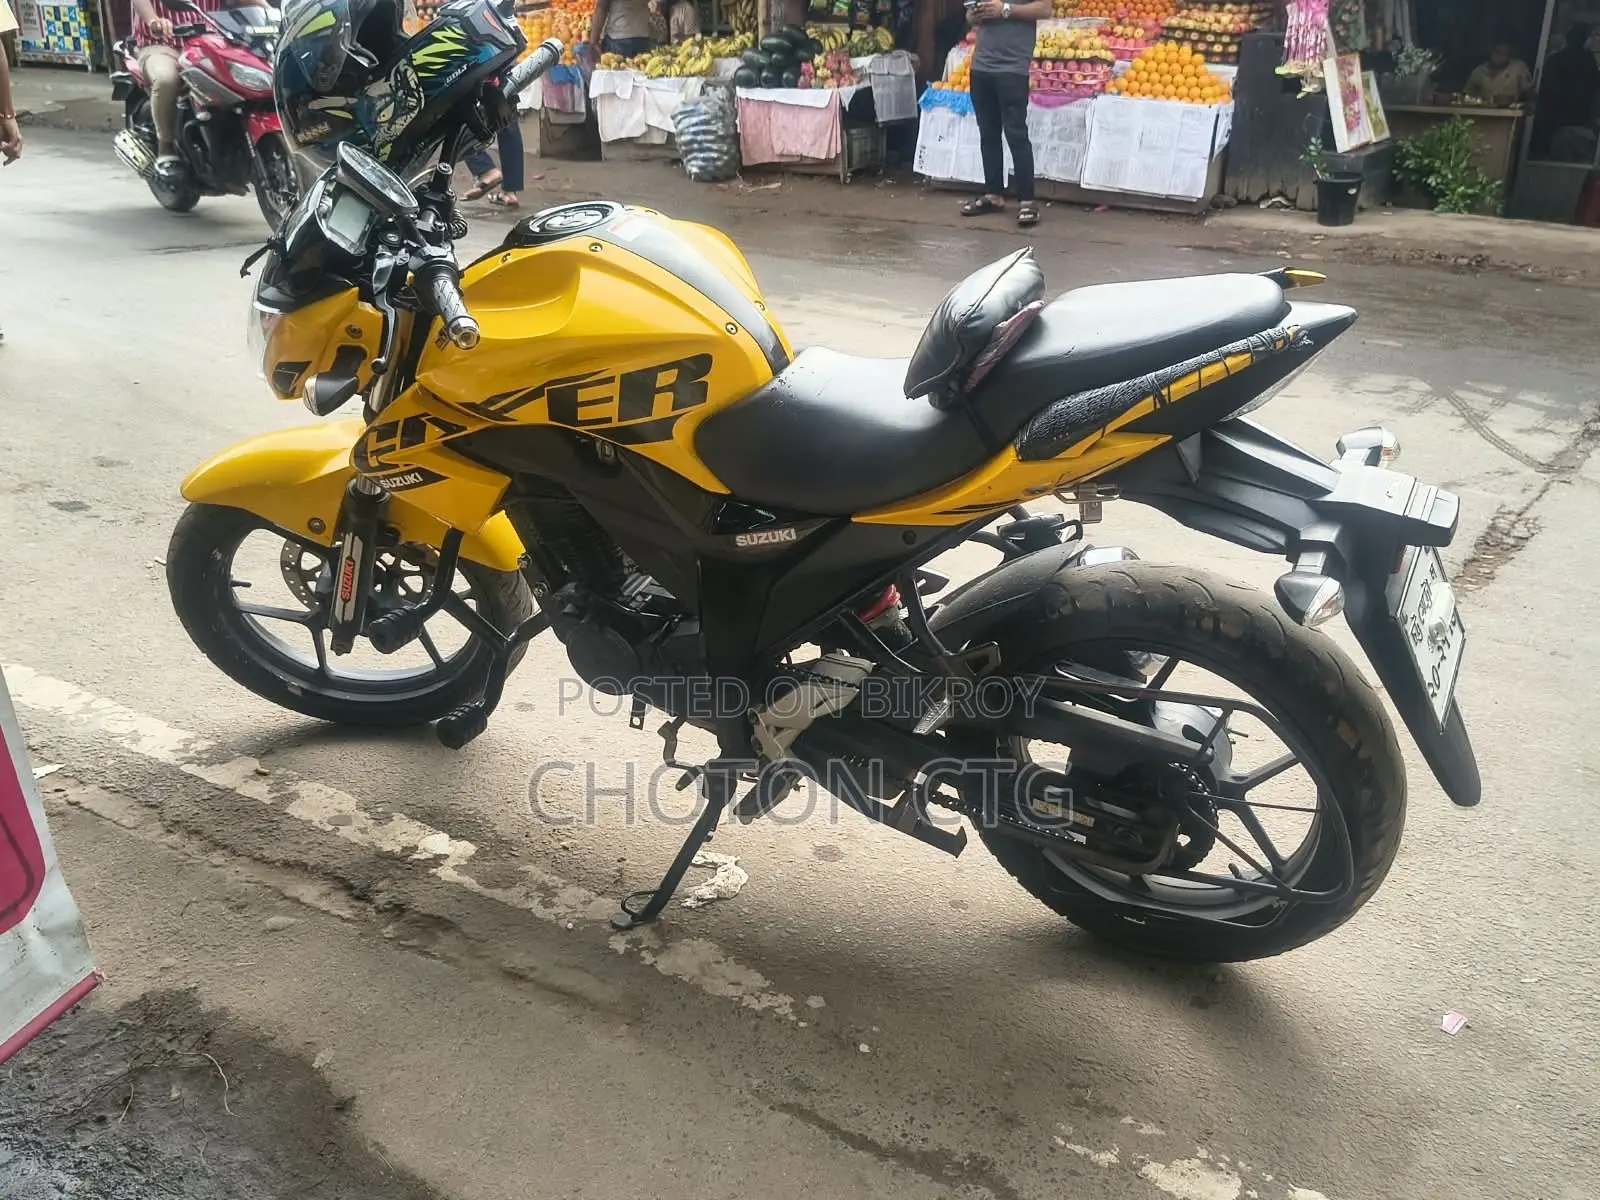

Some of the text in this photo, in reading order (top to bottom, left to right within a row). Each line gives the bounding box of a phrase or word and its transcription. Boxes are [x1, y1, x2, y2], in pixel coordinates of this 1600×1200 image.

[379, 472, 424, 490] SUZUKI
[735, 527, 797, 547] SUZUKI
[341, 559, 355, 601] SUZUKI
